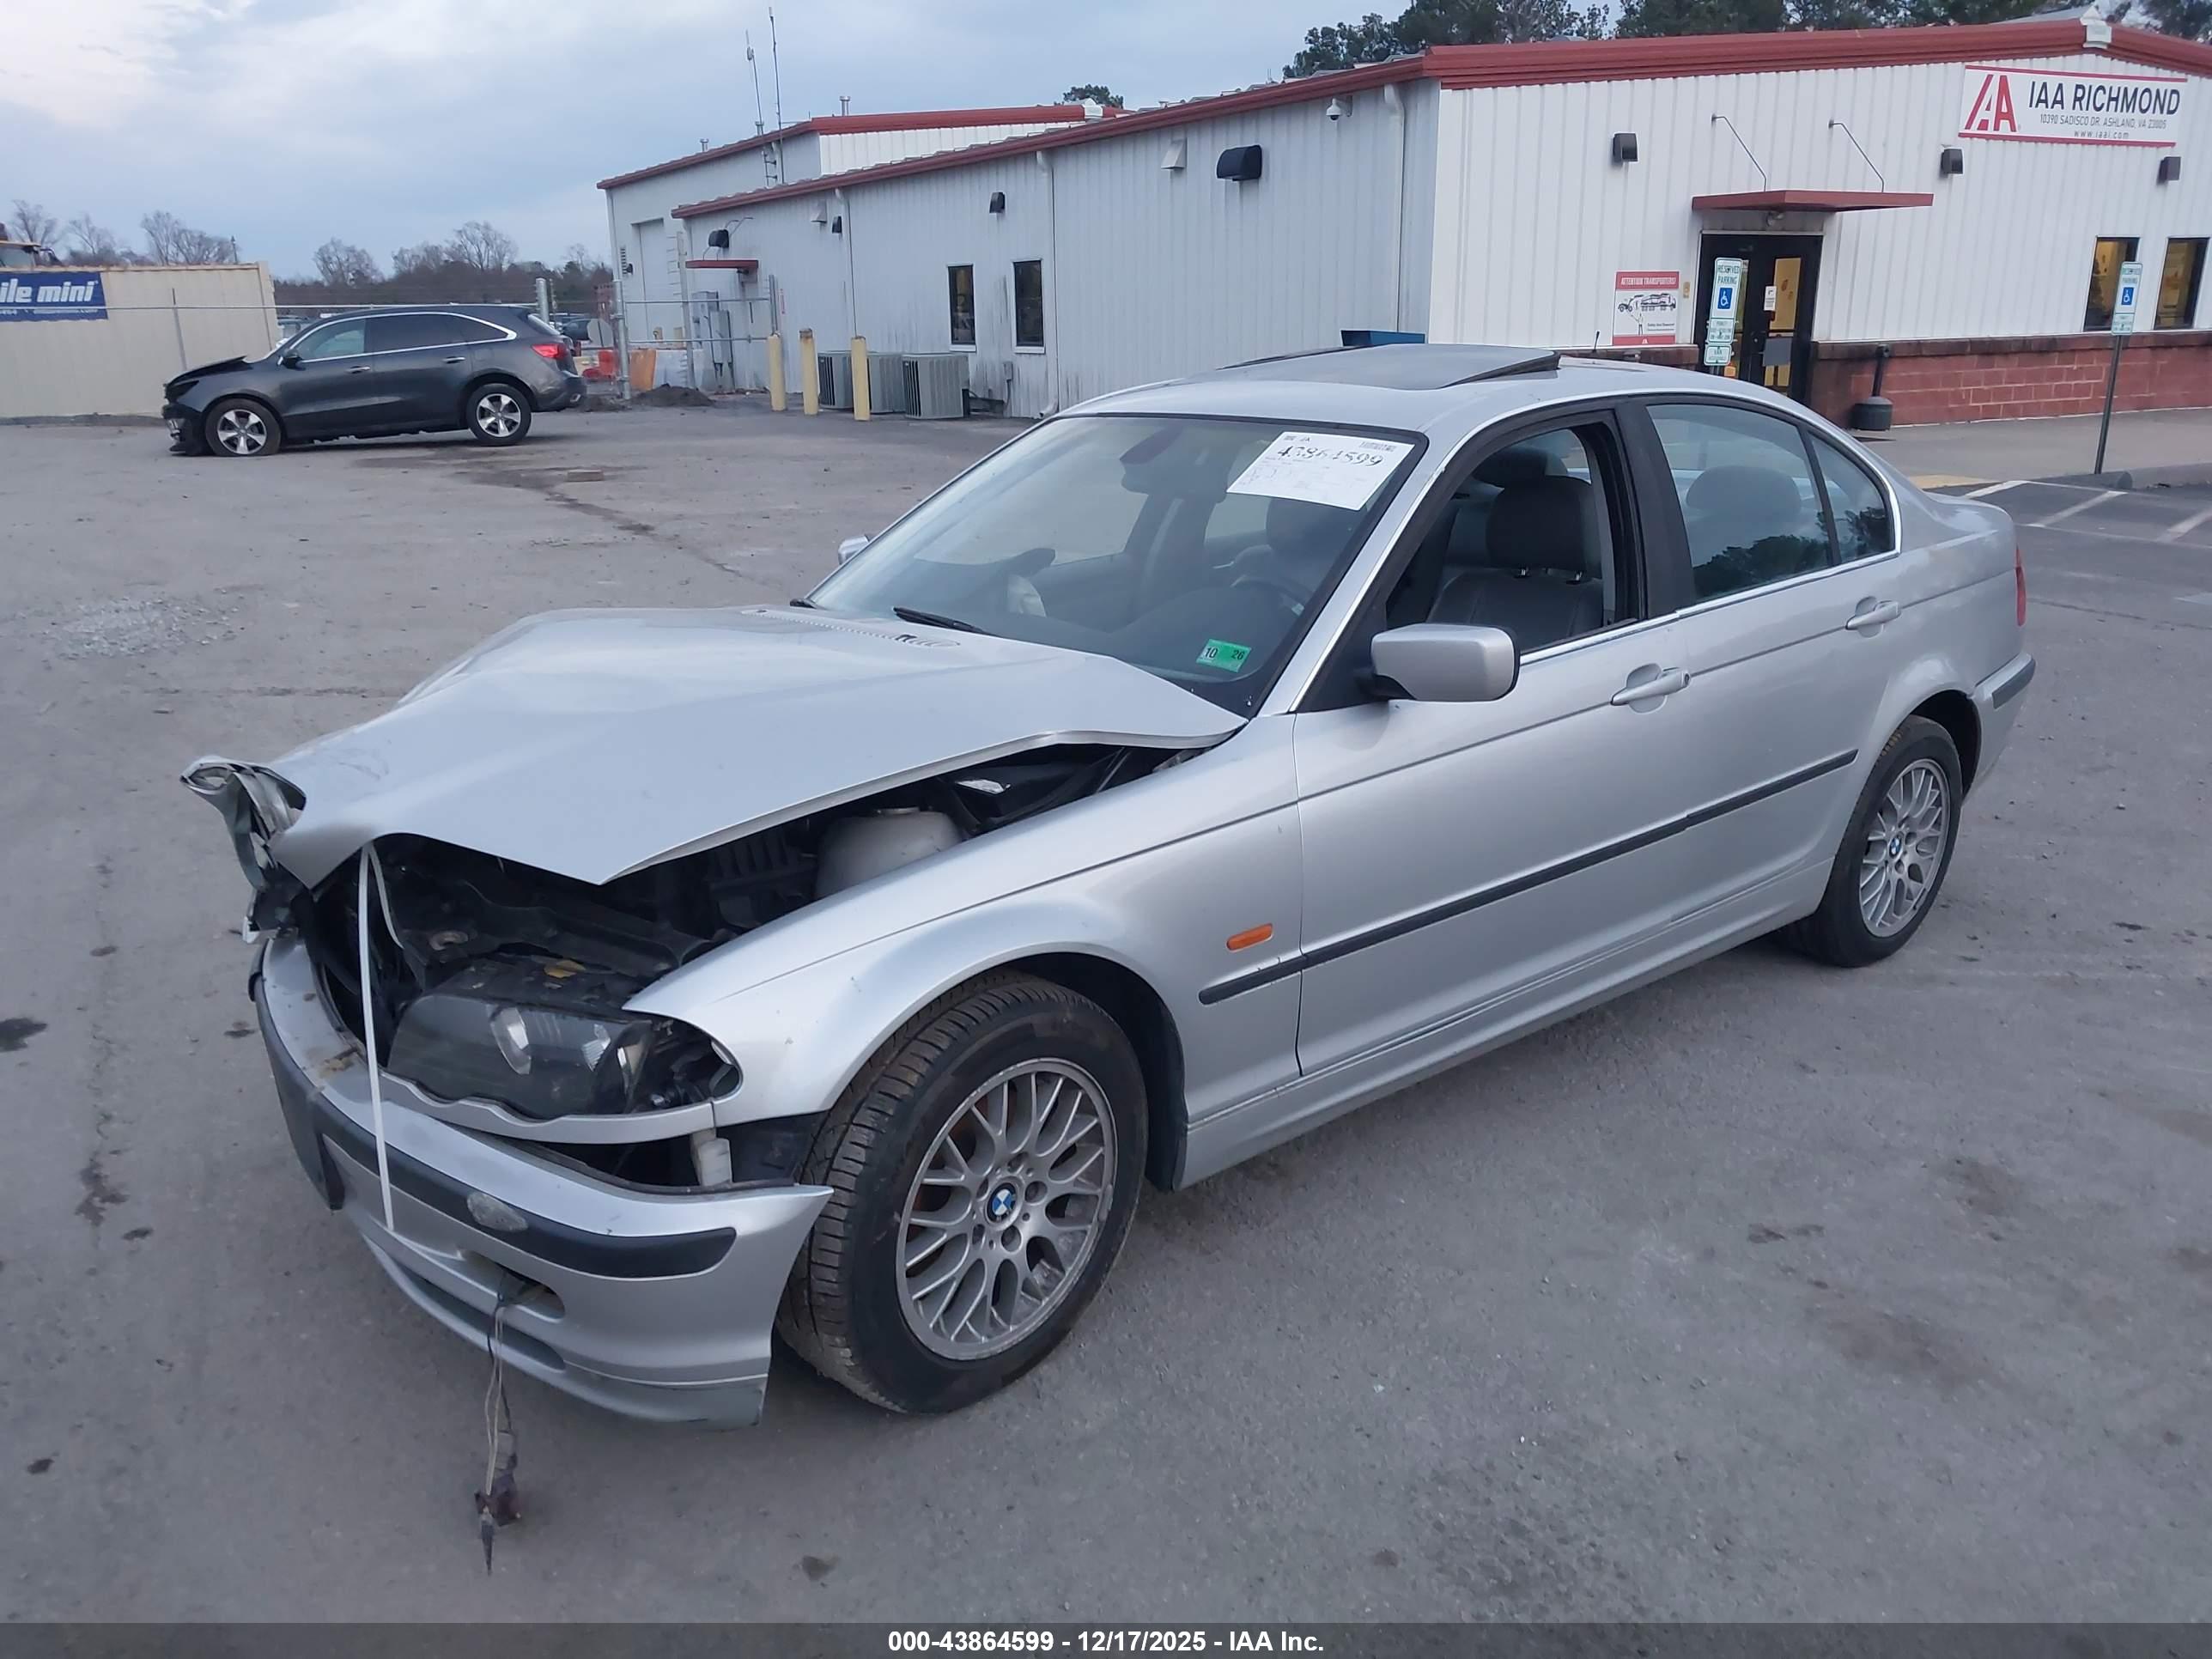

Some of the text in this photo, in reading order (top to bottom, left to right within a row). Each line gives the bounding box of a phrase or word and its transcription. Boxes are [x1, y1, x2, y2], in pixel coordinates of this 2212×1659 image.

[2028, 81, 2180, 115] IAA RICHMOND
[2039, 113, 2058, 125] 10390
[2060, 114, 2089, 126] SADISCO
[2137, 118, 2147, 129] VA
[1717, 276, 1739, 285] PARKING
[0, 278, 94, 303] ile mini
[1205, 647, 1245, 660] 10 26
